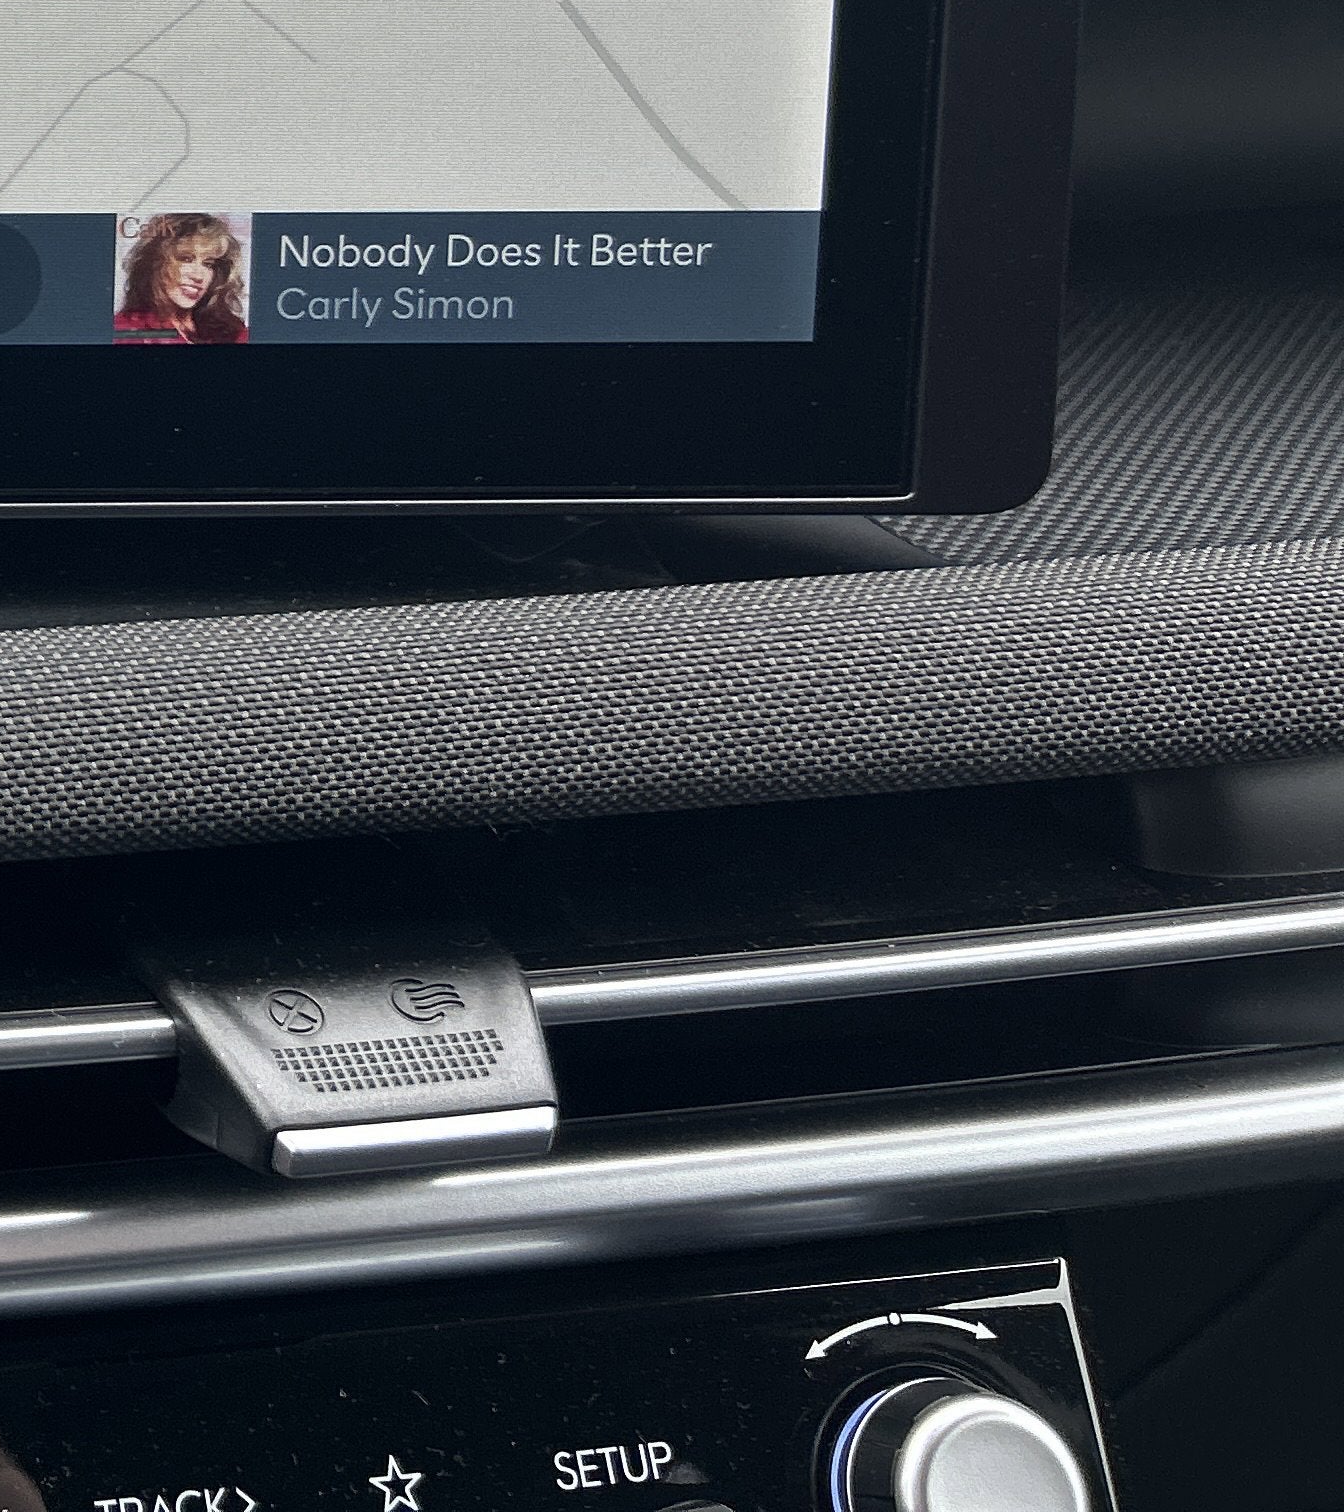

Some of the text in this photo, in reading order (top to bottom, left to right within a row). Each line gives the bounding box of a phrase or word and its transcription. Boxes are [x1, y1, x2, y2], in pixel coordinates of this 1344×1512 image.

[278, 233, 714, 275] Nobody Does It Better
[276, 287, 514, 328] Carly Simon
[553, 1441, 672, 1491] SETUP
